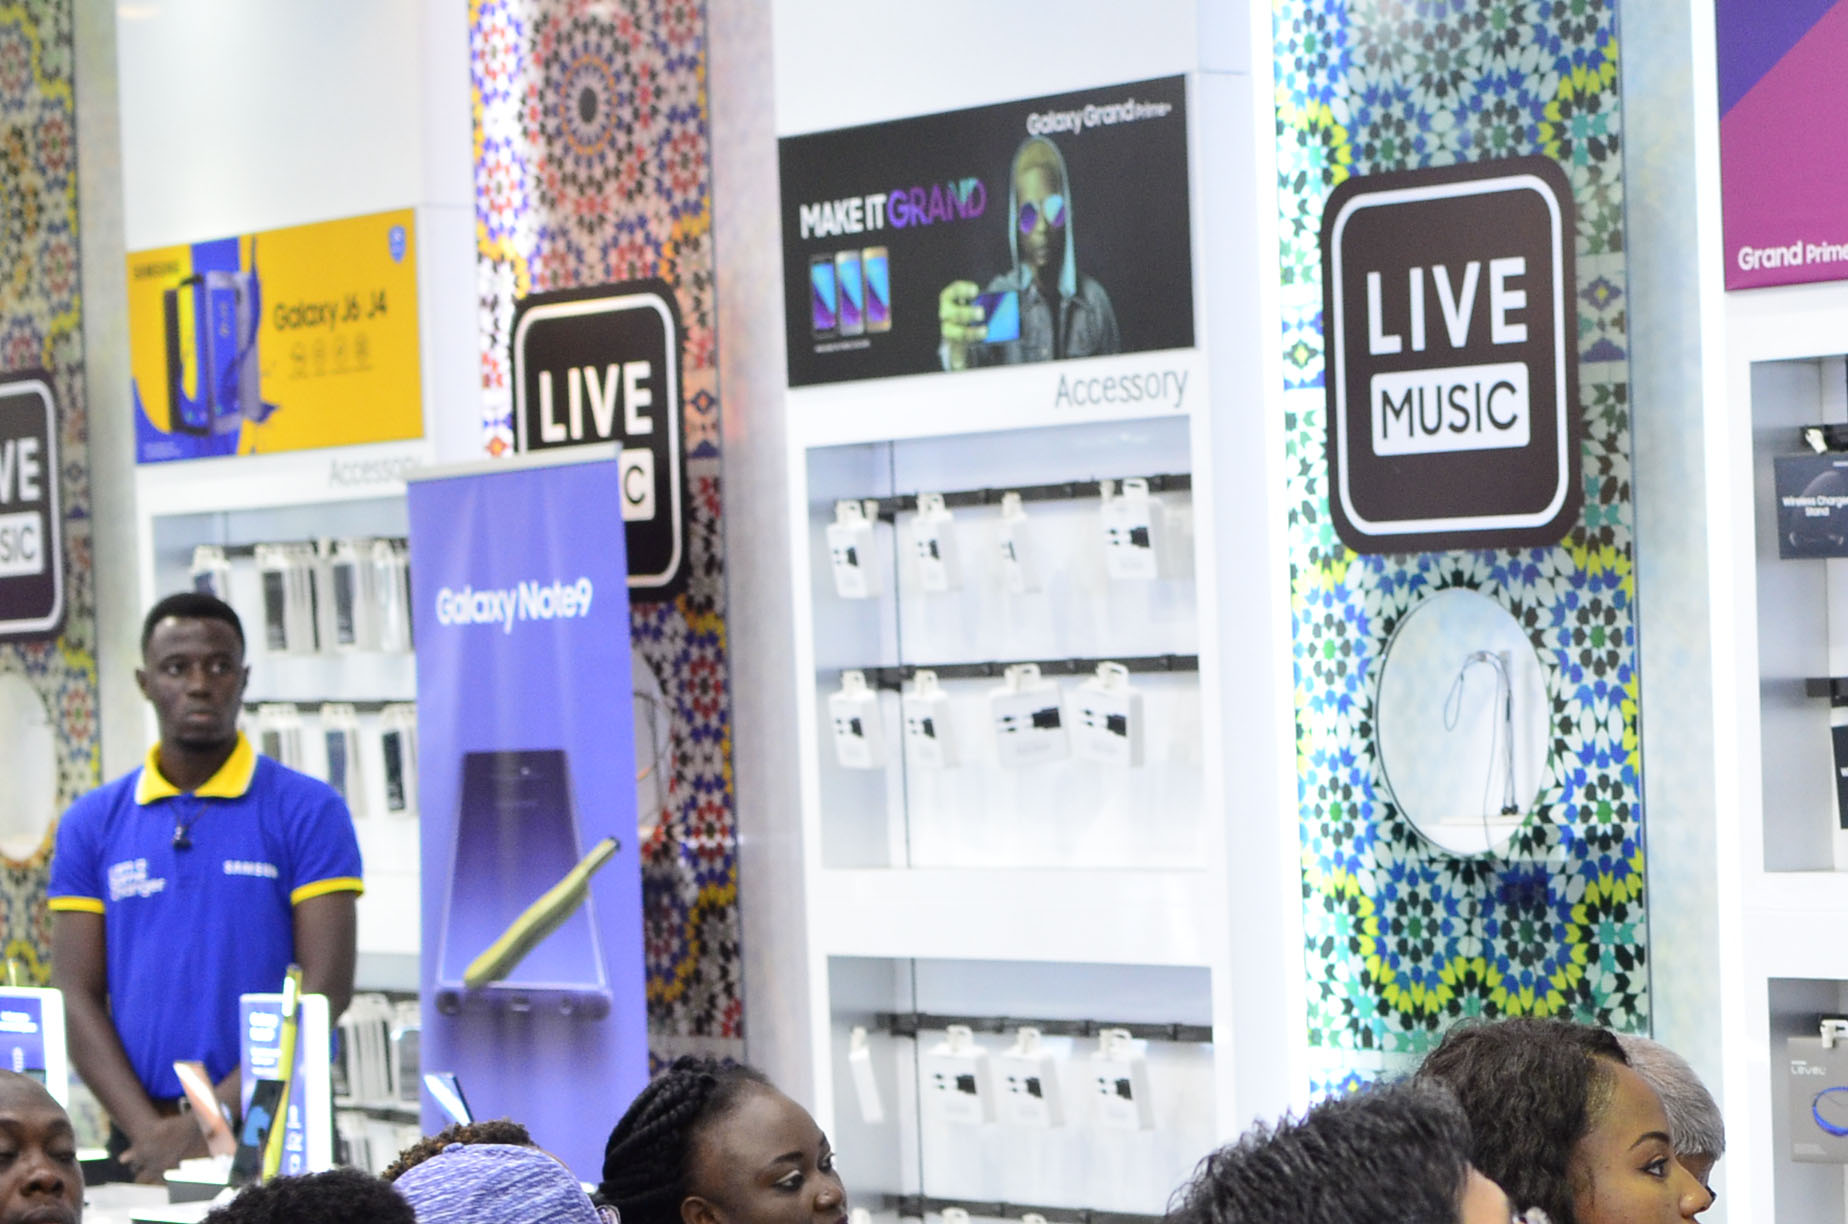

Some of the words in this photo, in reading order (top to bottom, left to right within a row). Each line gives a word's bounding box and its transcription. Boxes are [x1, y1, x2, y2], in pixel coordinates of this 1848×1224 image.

[800, 197, 864, 240] MAKE
[865, 193, 887, 231] IT
[887, 177, 987, 229] GRAND
[1738, 240, 1803, 271] Grand
[273, 301, 338, 333] Galaxy
[1367, 256, 1528, 355] LIVE
[539, 361, 653, 442] LIVE
[1054, 370, 1188, 408] Accessory
[1381, 381, 1518, 440] MUSIC
[0, 437, 41, 503] VE
[0, 526, 34, 562] SIC
[436, 584, 516, 635] Galaxy
[518, 576, 593, 620] Note9
